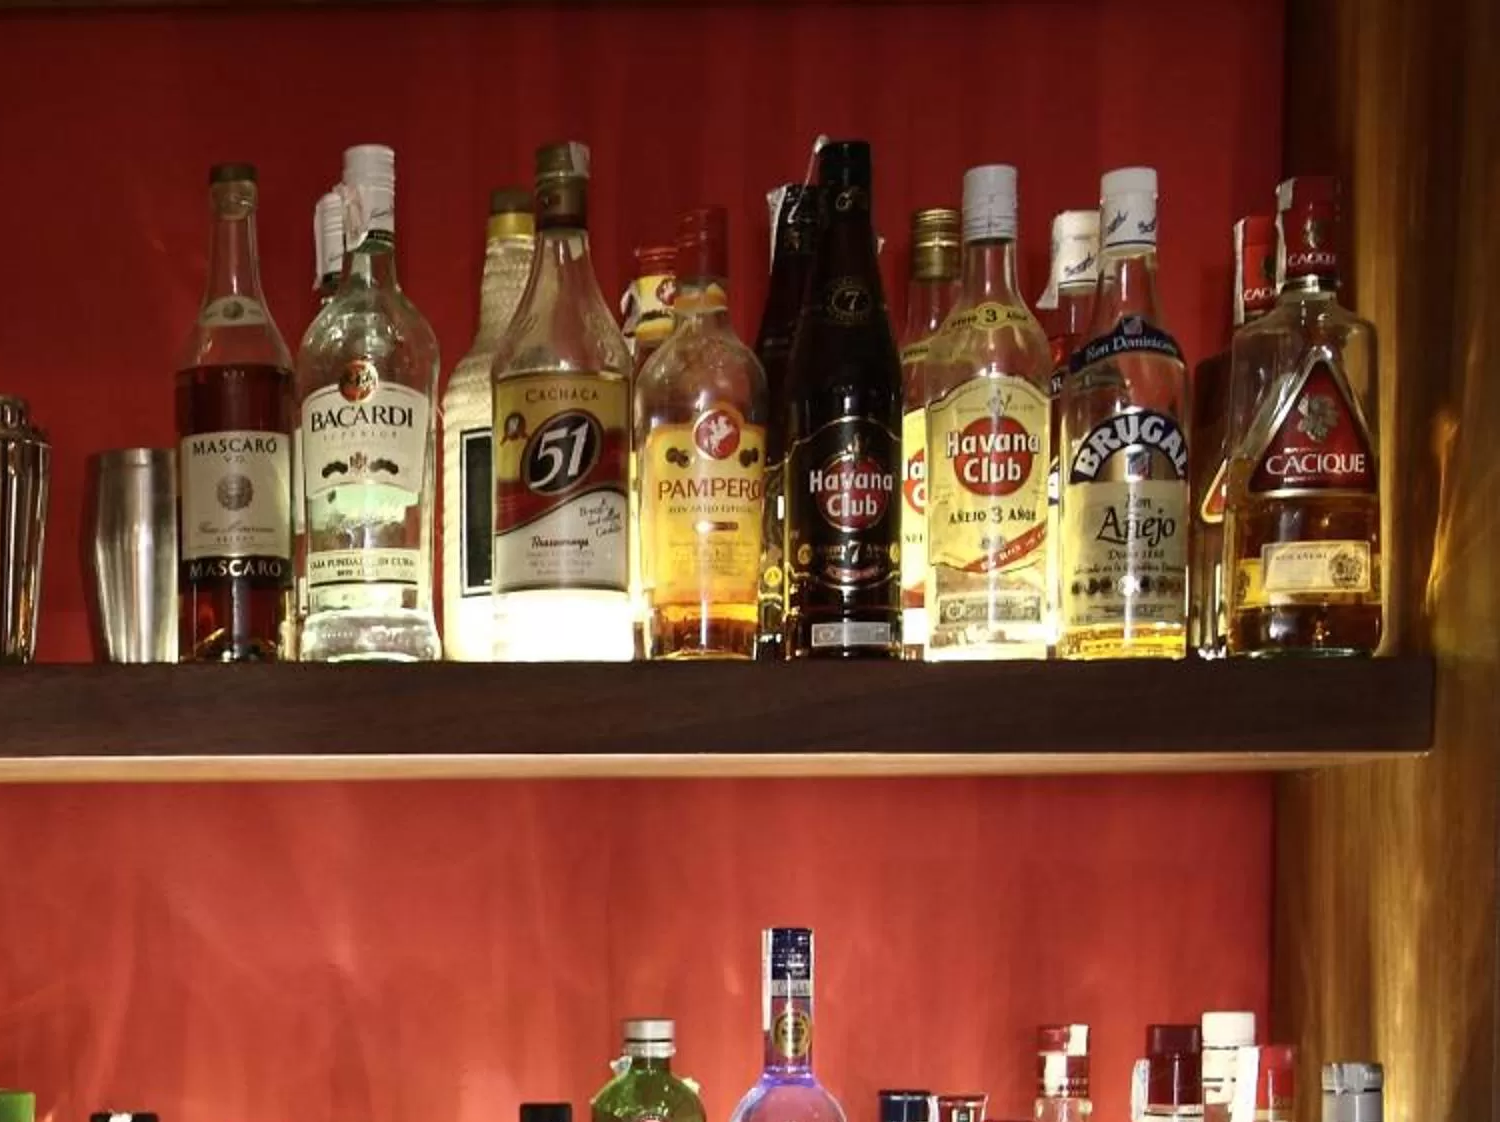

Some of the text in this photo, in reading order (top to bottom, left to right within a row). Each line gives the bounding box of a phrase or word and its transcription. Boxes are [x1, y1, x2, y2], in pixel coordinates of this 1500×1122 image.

[1243, 287, 1277, 301] CACI
[985, 309, 998, 322] 3
[529, 421, 589, 490] 51
[946, 431, 1041, 458] Havana
[1075, 412, 1186, 477] BRUGAL
[963, 455, 1022, 483] Club
[1265, 453, 1365, 475] CACIQUE
[658, 477, 761, 501] PAMPERO
[808, 469, 893, 494] Havana
[826, 496, 877, 517] Club
[991, 505, 1004, 524] 3
